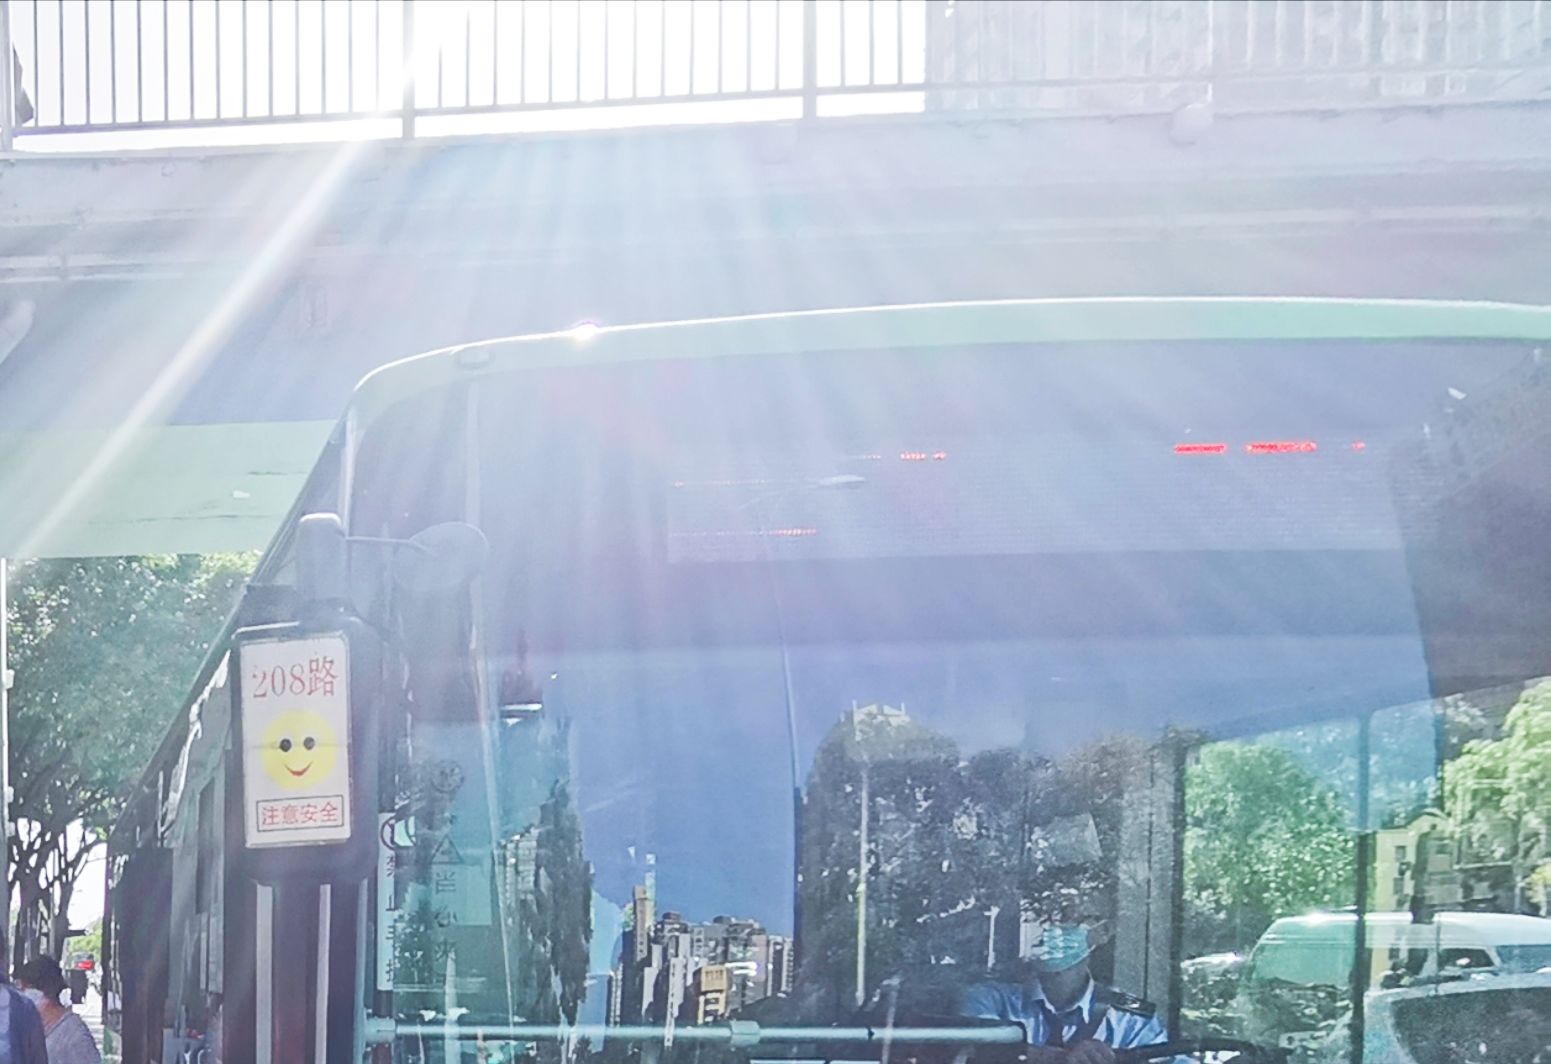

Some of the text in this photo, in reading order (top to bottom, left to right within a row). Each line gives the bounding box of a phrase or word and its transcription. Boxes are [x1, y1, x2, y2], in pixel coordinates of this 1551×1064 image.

[252, 655, 338, 698] 208路
[261, 802, 339, 827] 注意安全
